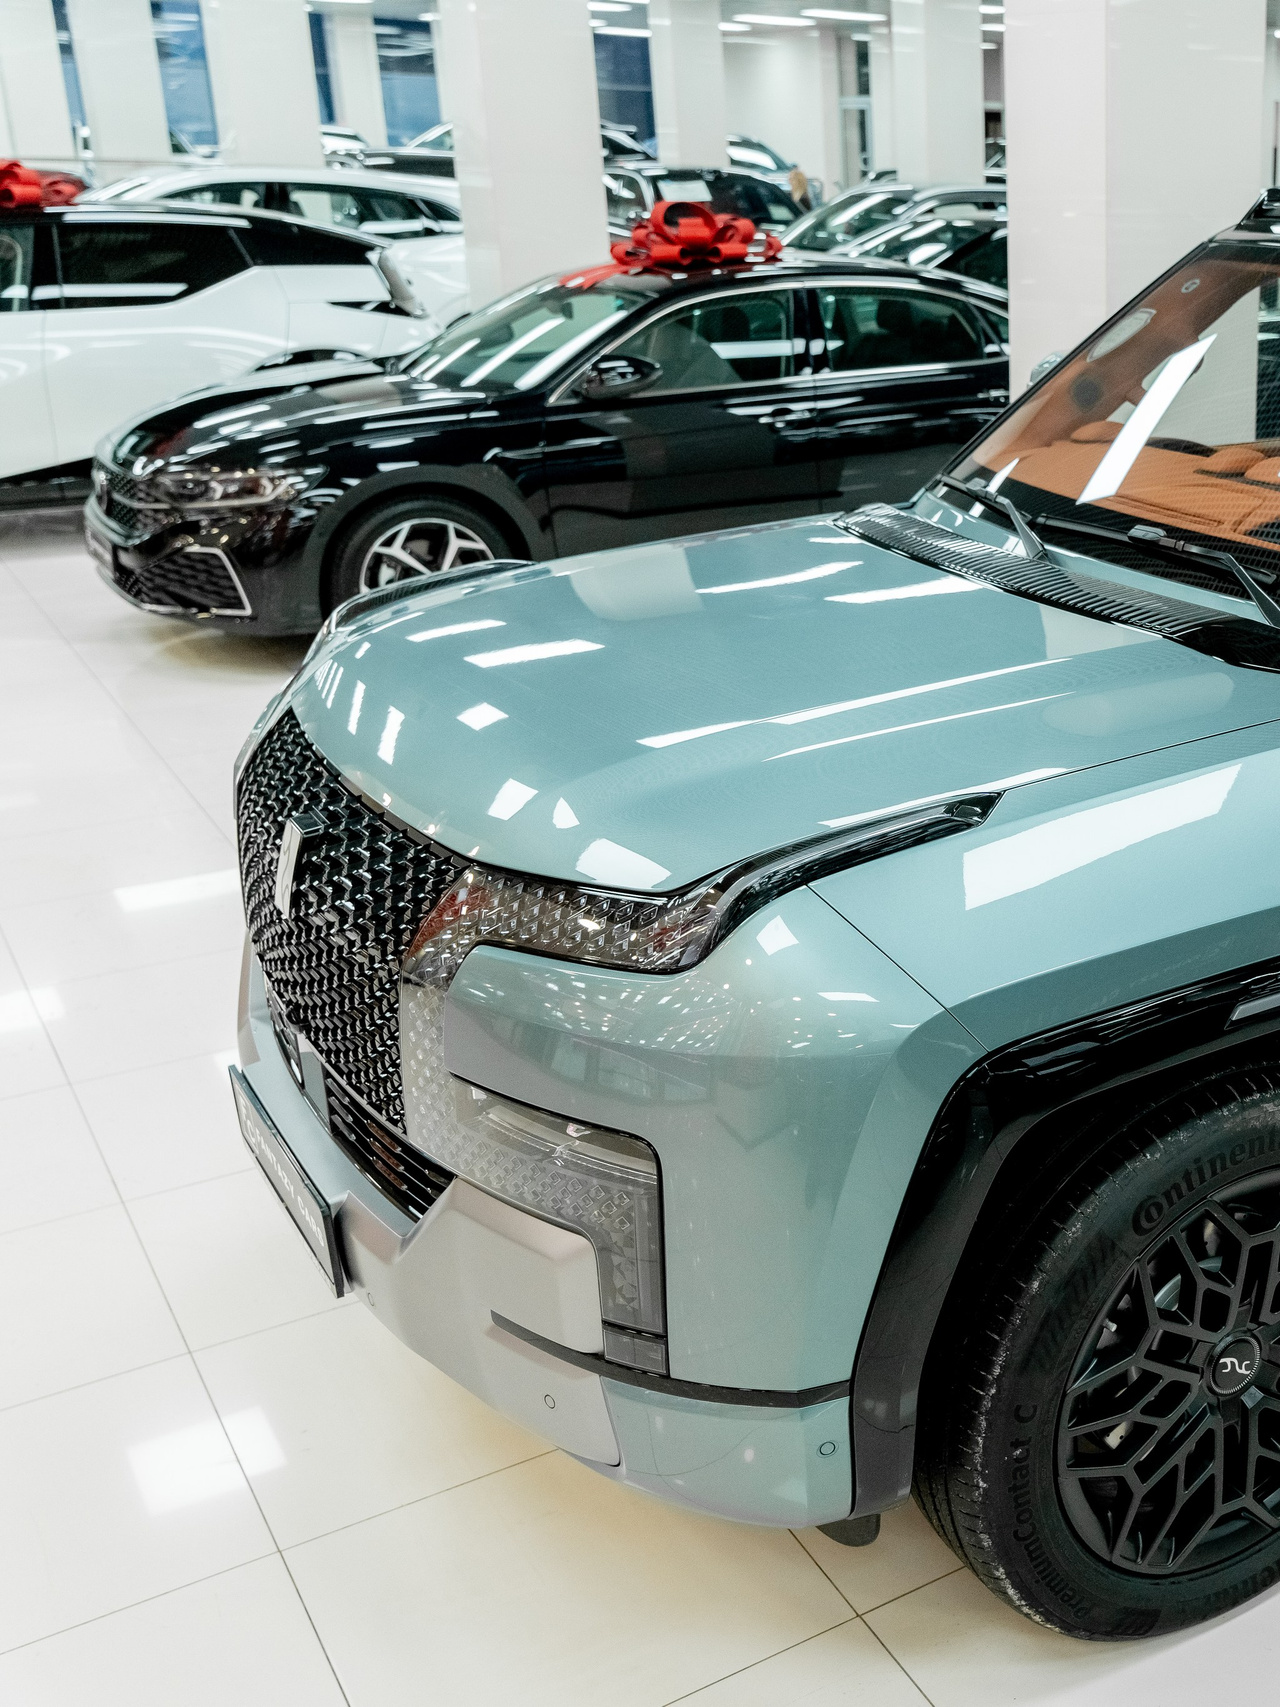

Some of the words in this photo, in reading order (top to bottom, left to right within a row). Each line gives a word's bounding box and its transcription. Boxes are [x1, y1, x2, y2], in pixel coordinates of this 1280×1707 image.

[255, 1131, 295, 1197] FANTAZY
[297, 1195, 325, 1247] CARS
[1017, 1403, 1039, 1425] C
[1012, 1434, 1093, 1620] PremiumContact
